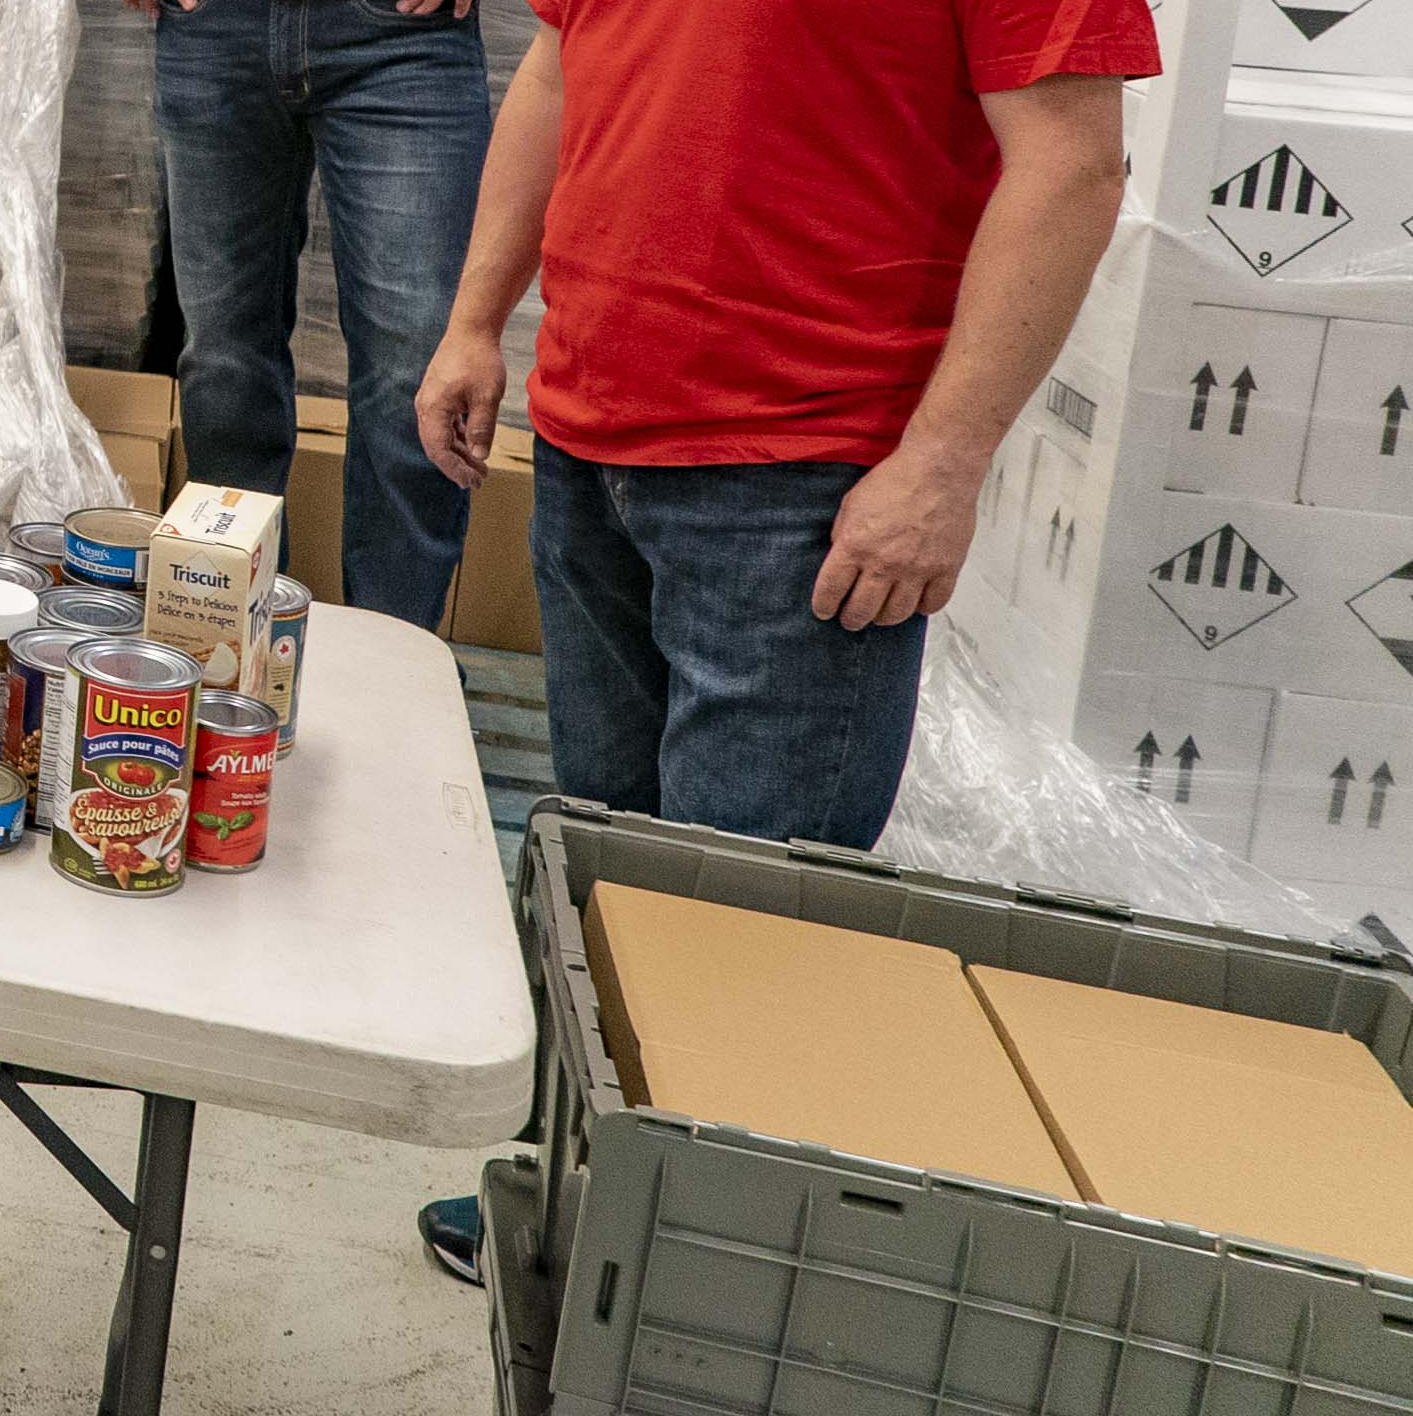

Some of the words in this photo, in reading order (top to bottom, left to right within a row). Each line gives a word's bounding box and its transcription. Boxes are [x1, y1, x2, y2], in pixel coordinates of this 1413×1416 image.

[1258, 251, 1272, 268] 9
[76, 541, 110, 561] Ocean's
[169, 563, 231, 590] Triscuit
[157, 591, 165, 599] 3
[167, 591, 189, 606] Steps
[192, 596, 201, 606] to
[204, 597, 239, 613] Delicious
[183, 610, 195, 619] en
[199, 613, 206, 622] 3
[1204, 624, 1218, 642] 9
[94, 694, 182, 729] Unico
[87, 740, 119, 754] Sauce
[122, 740, 152, 754] pour
[154, 744, 179, 762] pâtes
[206, 751, 274, 775] AYLME
[103, 776, 163, 796] ORIGINALE
[75, 796, 143, 826] Épaisse
[145, 801, 158, 817] &
